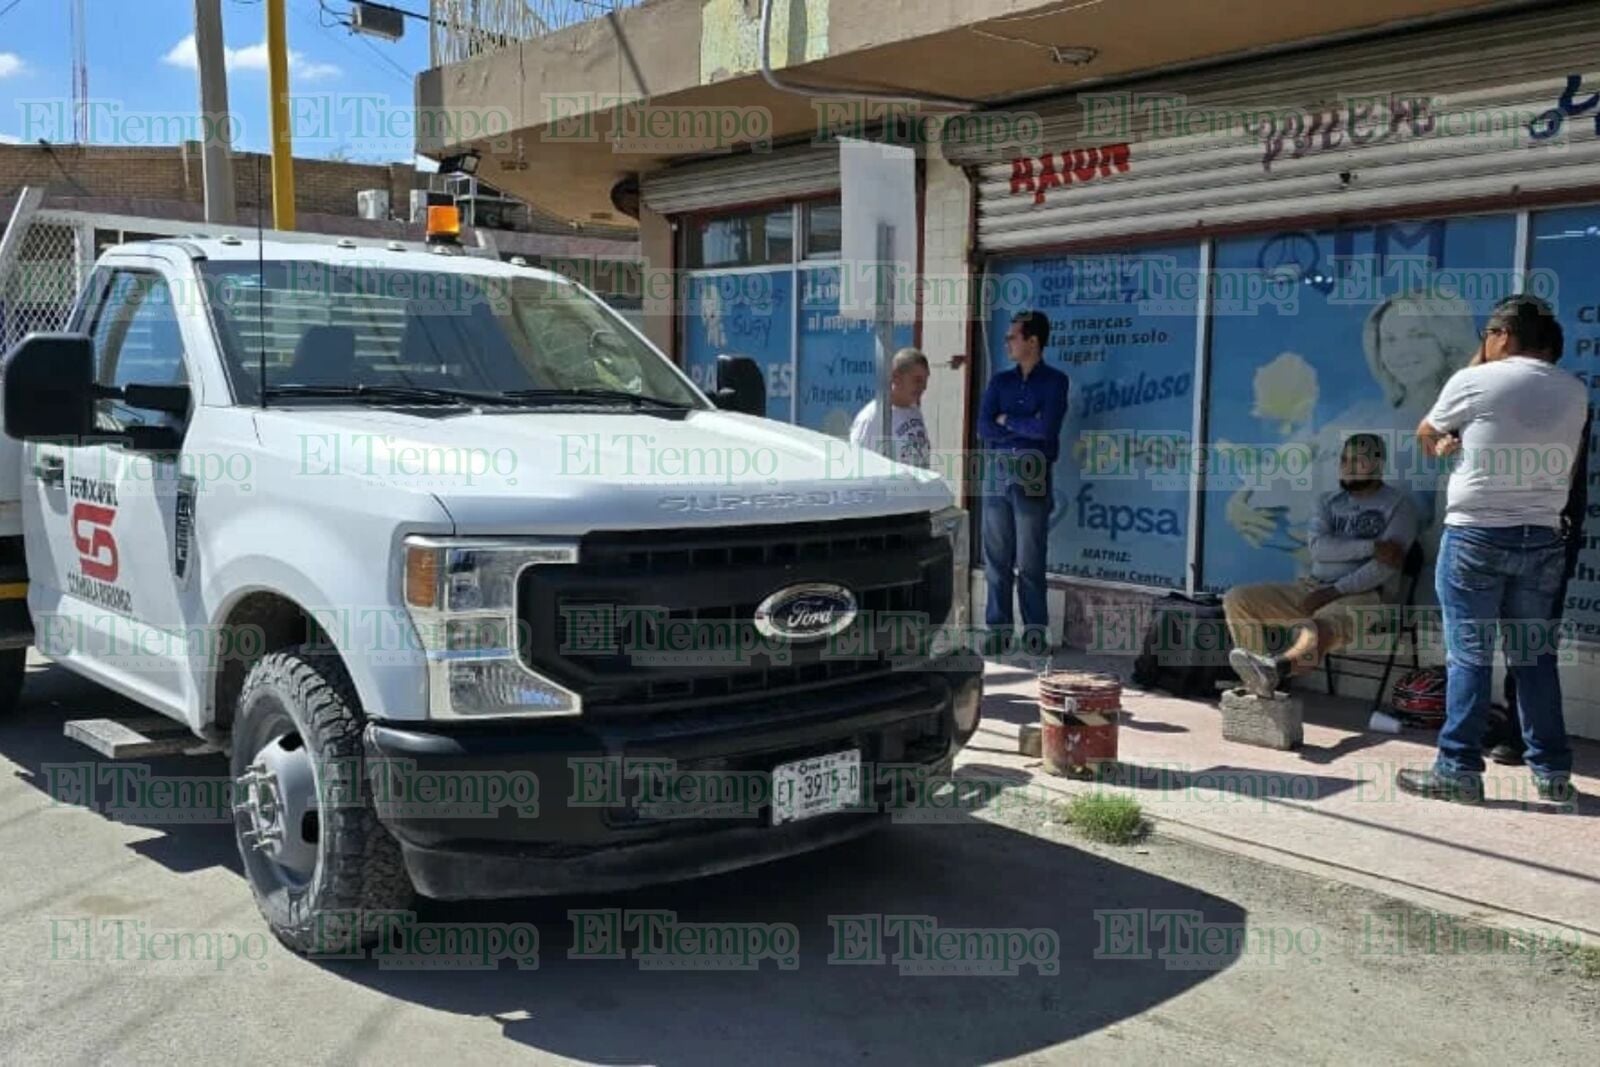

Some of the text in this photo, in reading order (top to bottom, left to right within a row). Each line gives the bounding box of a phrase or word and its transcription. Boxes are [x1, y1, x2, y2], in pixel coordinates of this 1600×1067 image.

[1071, 316, 1133, 331] marcas
[1079, 335, 1100, 347] en
[1132, 329, 1168, 345] solo
[1080, 371, 1191, 417] Fabuloso
[1074, 483, 1182, 540] fapsa
[786, 599, 833, 626] Ford
